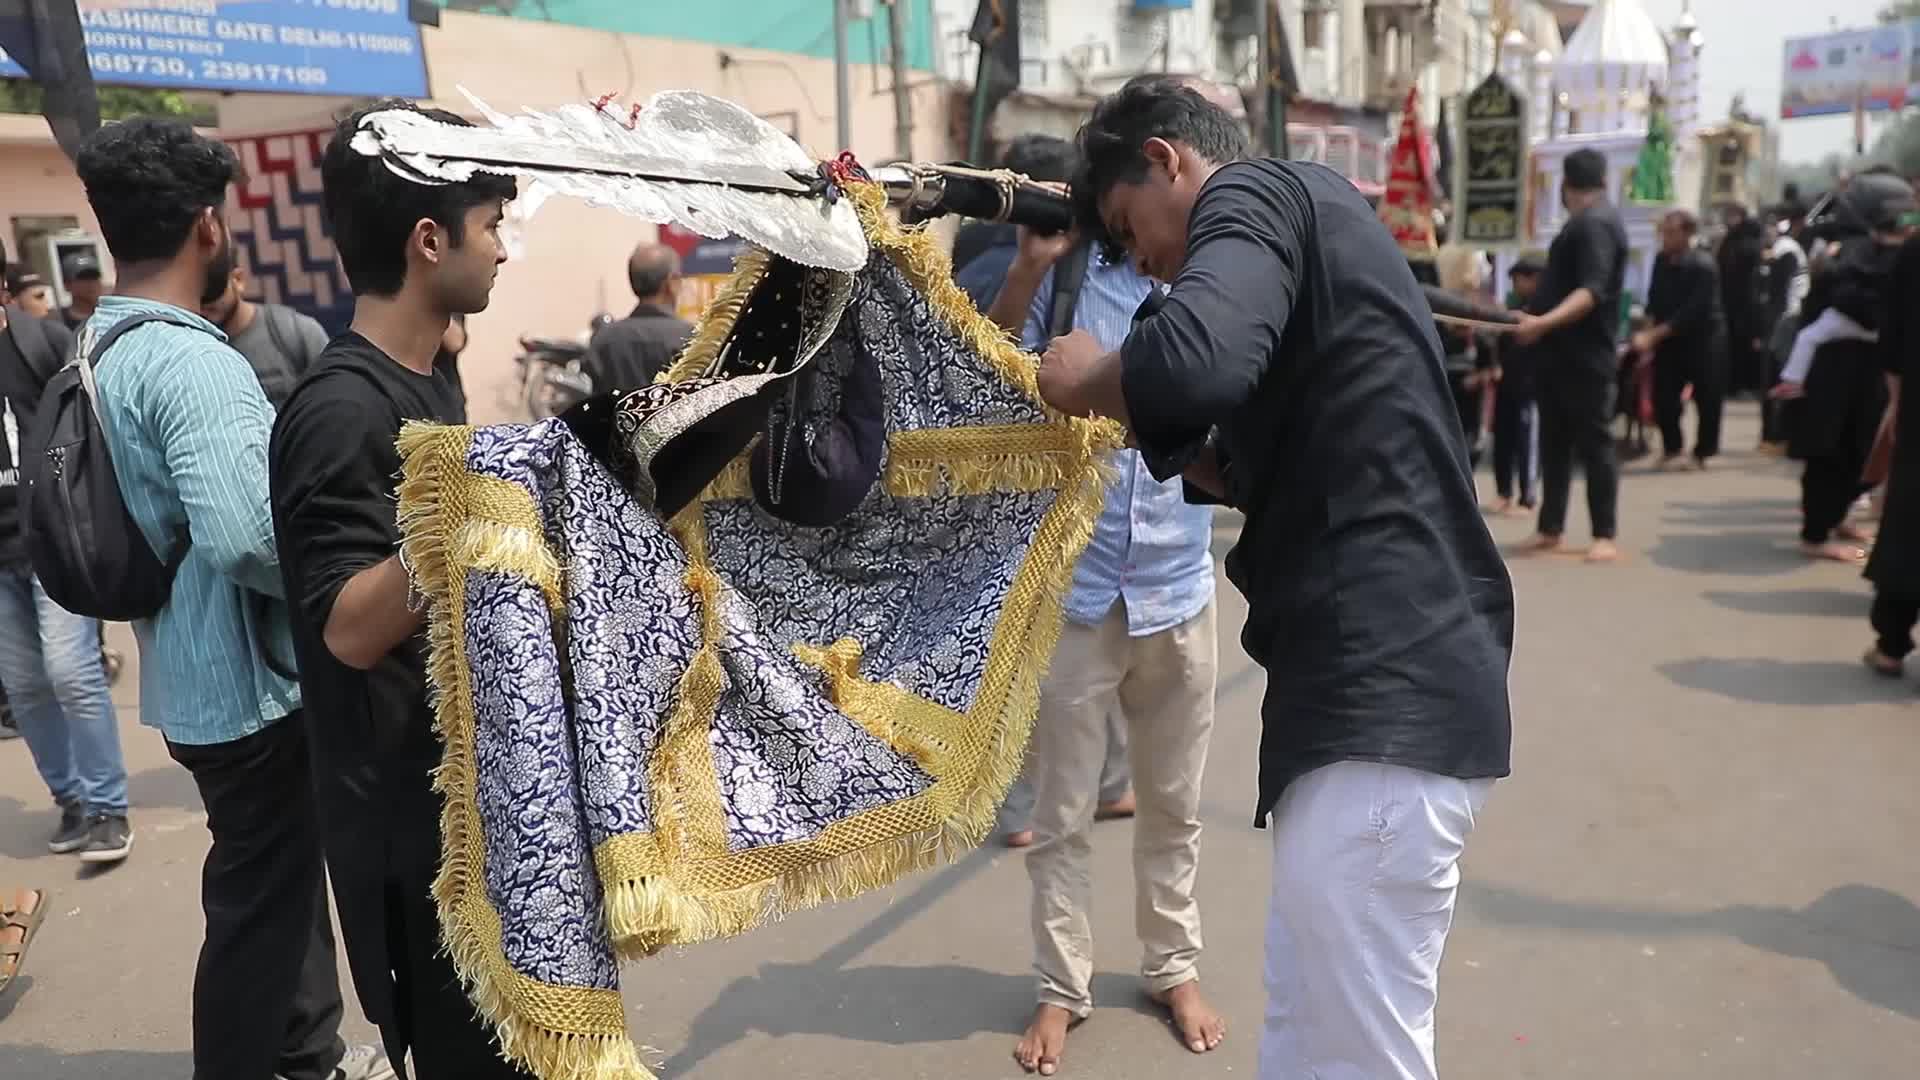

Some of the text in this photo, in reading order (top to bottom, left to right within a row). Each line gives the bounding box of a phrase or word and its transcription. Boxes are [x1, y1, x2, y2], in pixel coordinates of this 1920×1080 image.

[215, 20, 273, 43] GATE
[147, 37, 225, 57] DISTRICT
[202, 59, 328, 85] 23917100
